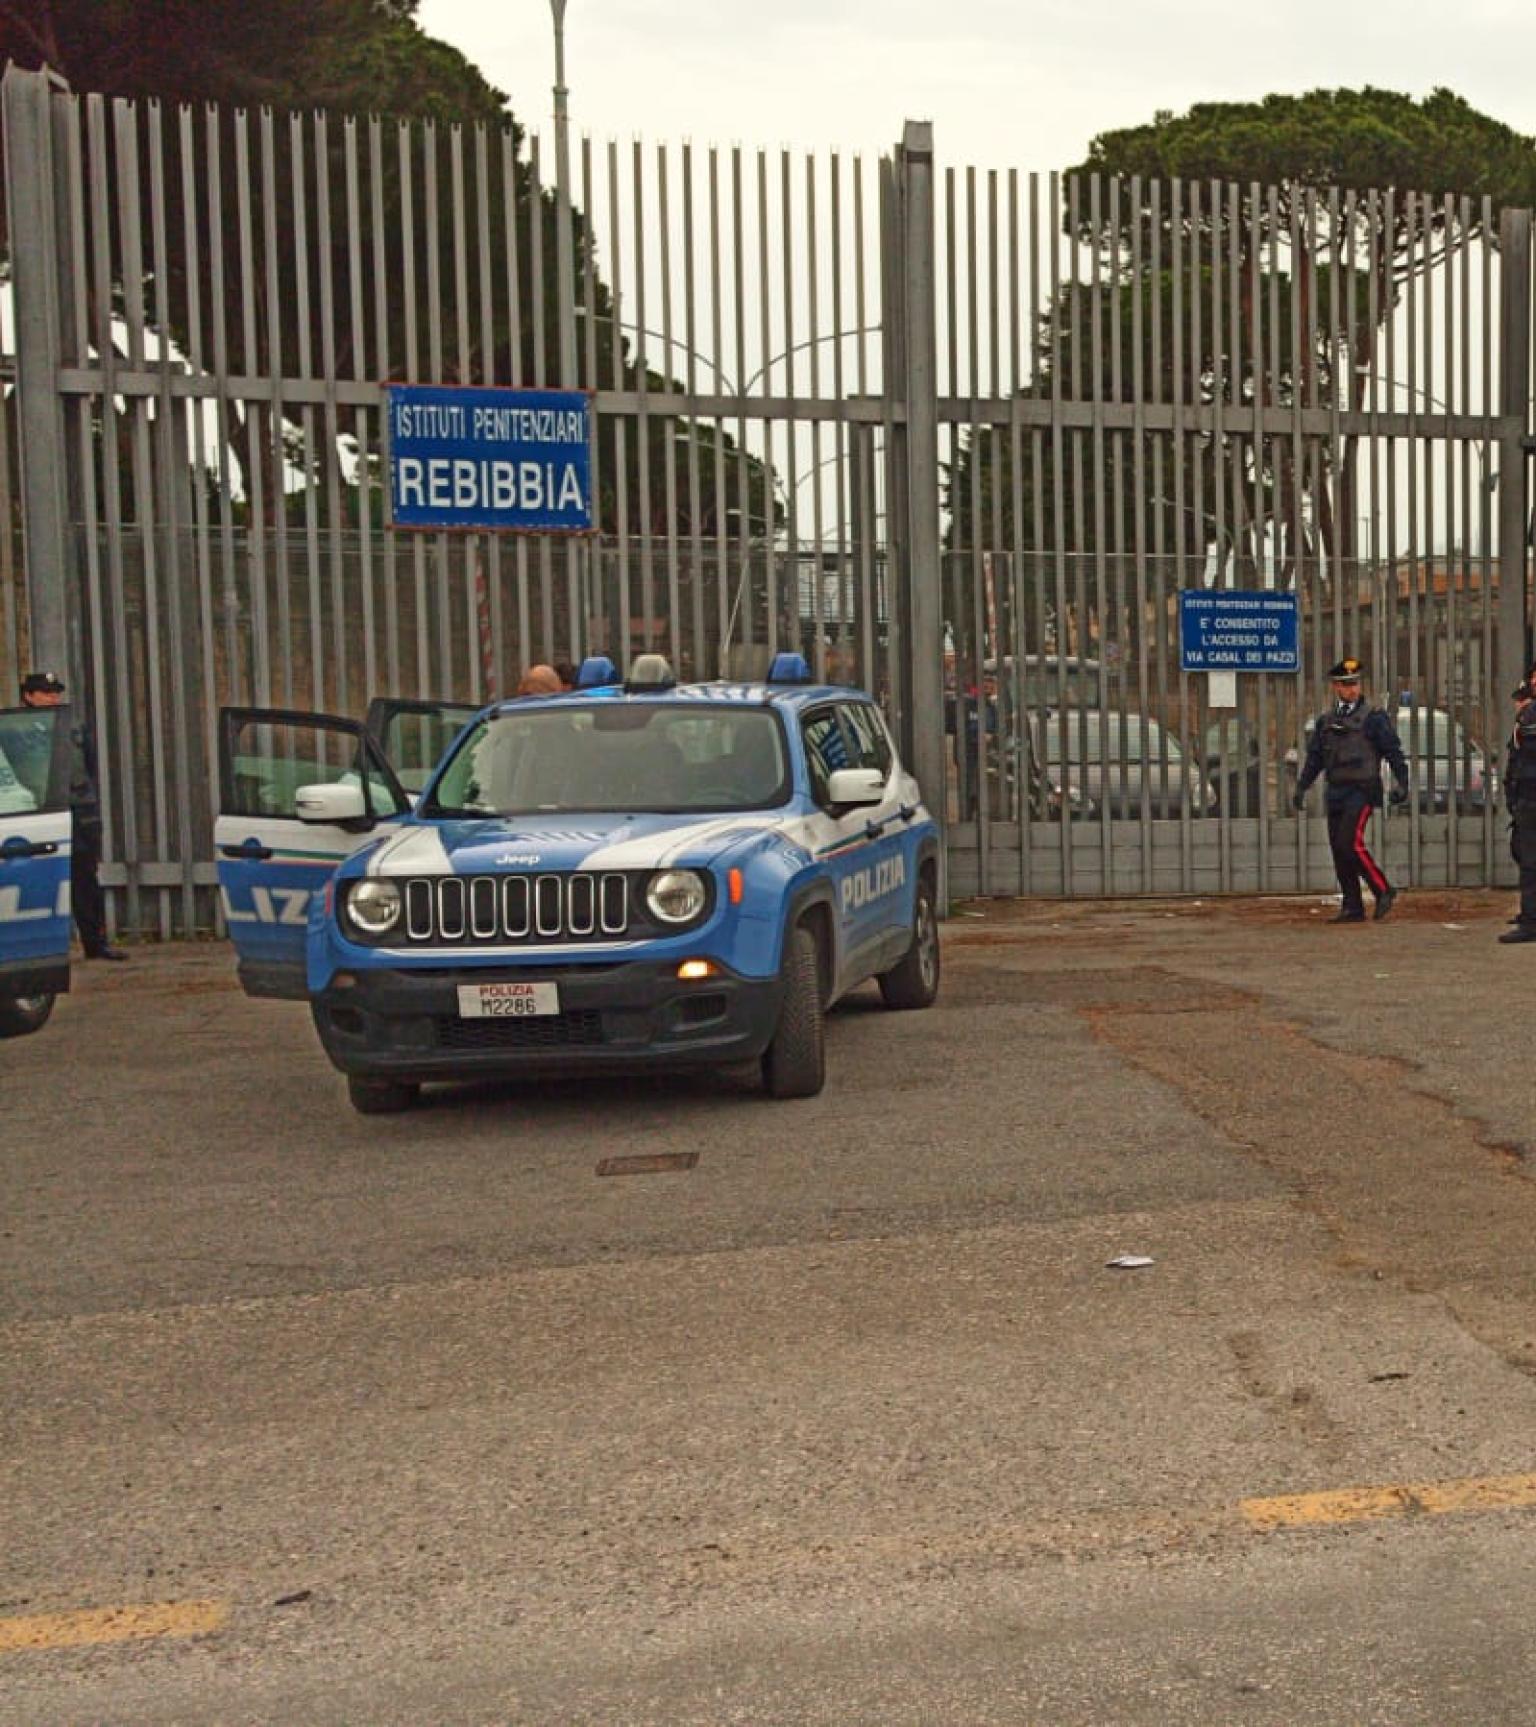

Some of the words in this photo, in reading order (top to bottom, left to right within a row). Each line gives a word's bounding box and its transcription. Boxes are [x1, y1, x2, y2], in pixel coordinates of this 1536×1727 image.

[397, 404, 466, 439] ISTITUTI
[473, 407, 583, 443] PENITENZIARI
[400, 458, 584, 511] REBIBBIA
[1214, 618, 1280, 629] CONSENTITO
[1202, 634, 1259, 646] L'ACCESSO
[1264, 635, 1279, 646] DA
[1187, 651, 1203, 662] VIA
[1208, 651, 1240, 663] CASAL
[495, 855, 540, 867] Jeep
[841, 852, 905, 915] POLIZIA
[479, 985, 534, 997] POLIZIA
